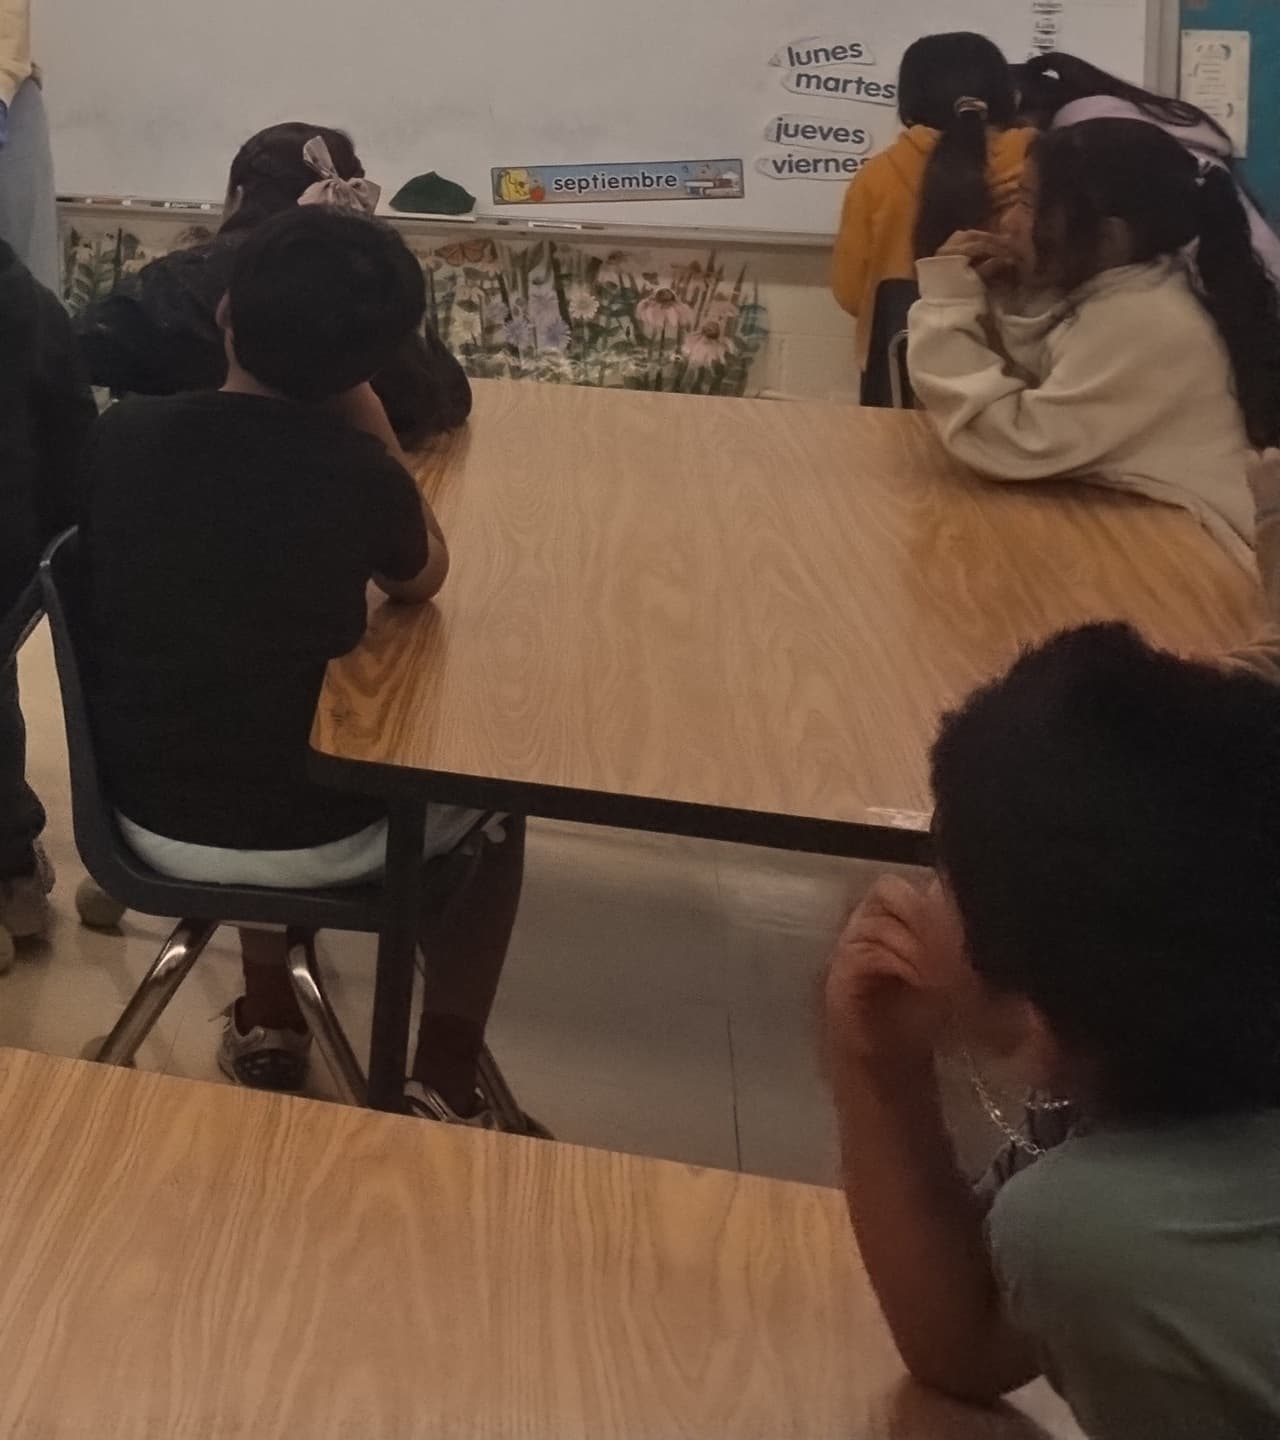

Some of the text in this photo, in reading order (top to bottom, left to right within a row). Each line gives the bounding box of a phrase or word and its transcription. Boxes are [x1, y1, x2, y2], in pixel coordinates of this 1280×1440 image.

[787, 42, 863, 68] lunes
[795, 71, 897, 99] martes
[775, 117, 865, 146] jueves
[553, 171, 678, 194] septiembre
